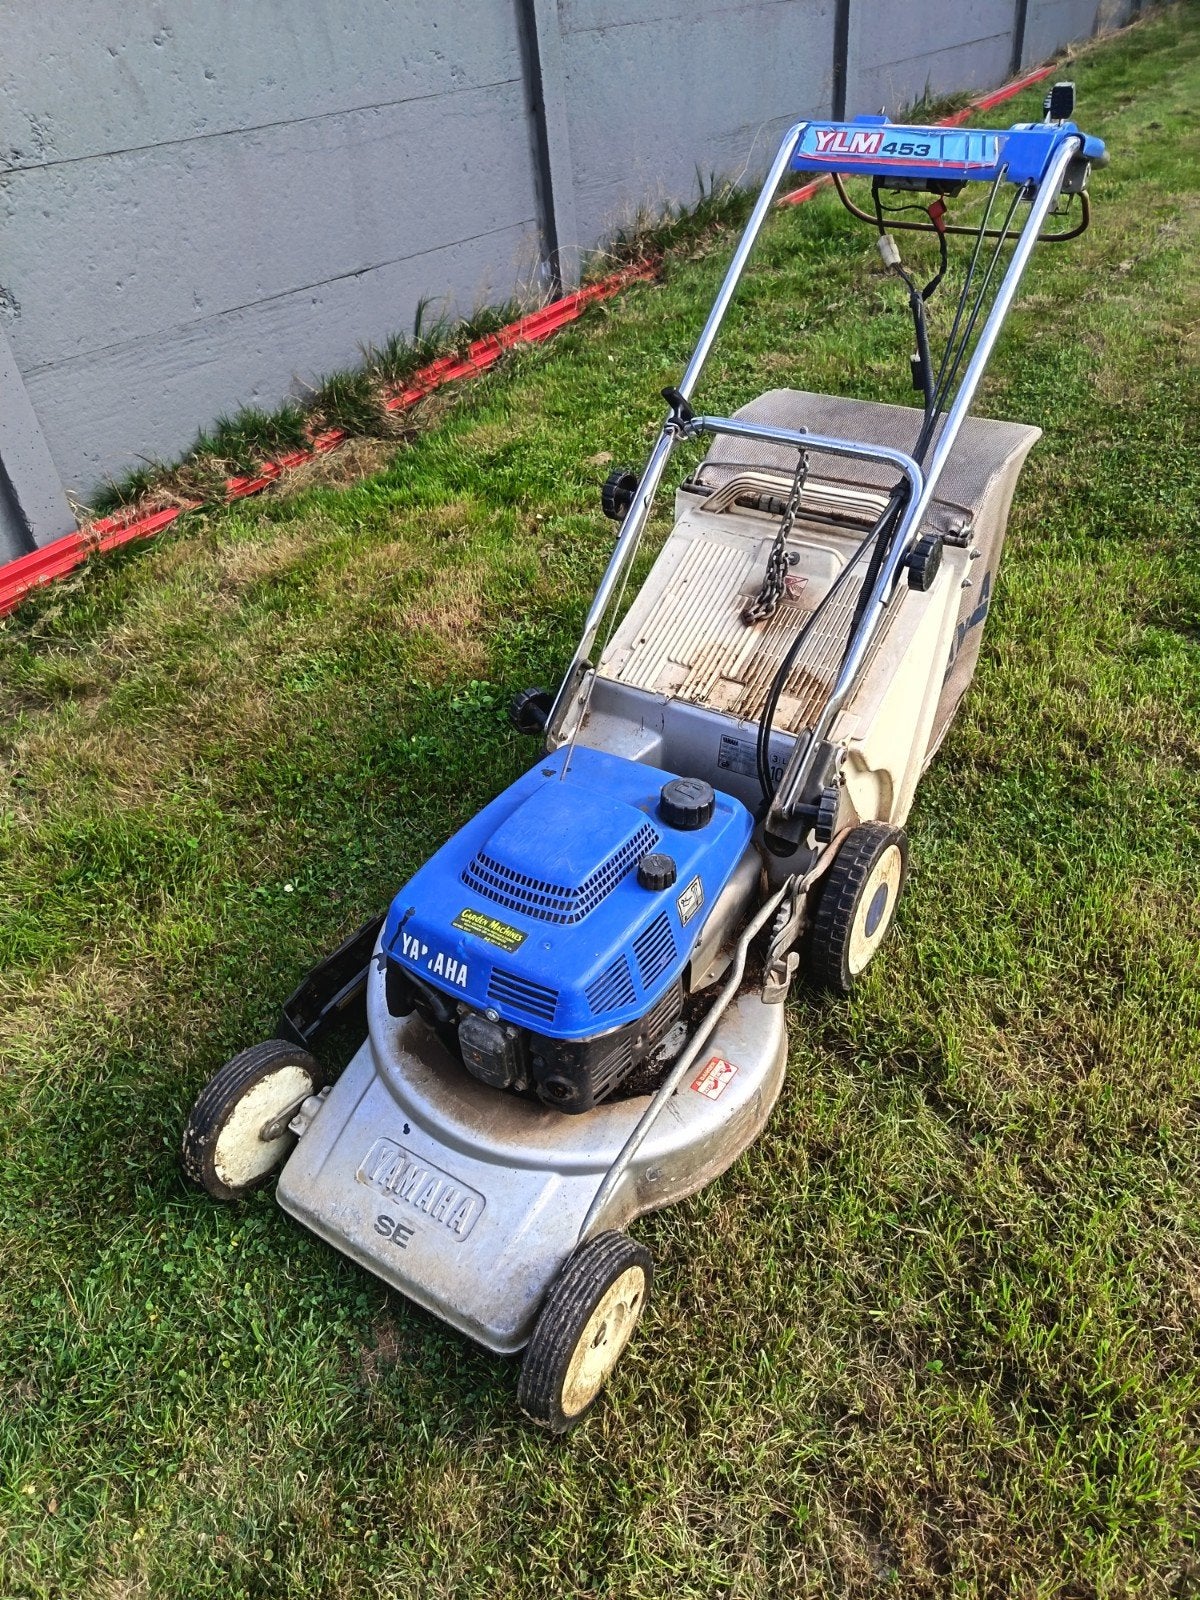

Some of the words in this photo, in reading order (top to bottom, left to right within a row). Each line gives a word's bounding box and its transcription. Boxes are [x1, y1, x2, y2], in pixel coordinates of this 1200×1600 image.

[815, 130, 884, 154] YLM
[882, 142, 931, 157] 453
[368, 1146, 476, 1234] YAMAHA
[373, 1214, 415, 1249] SE
